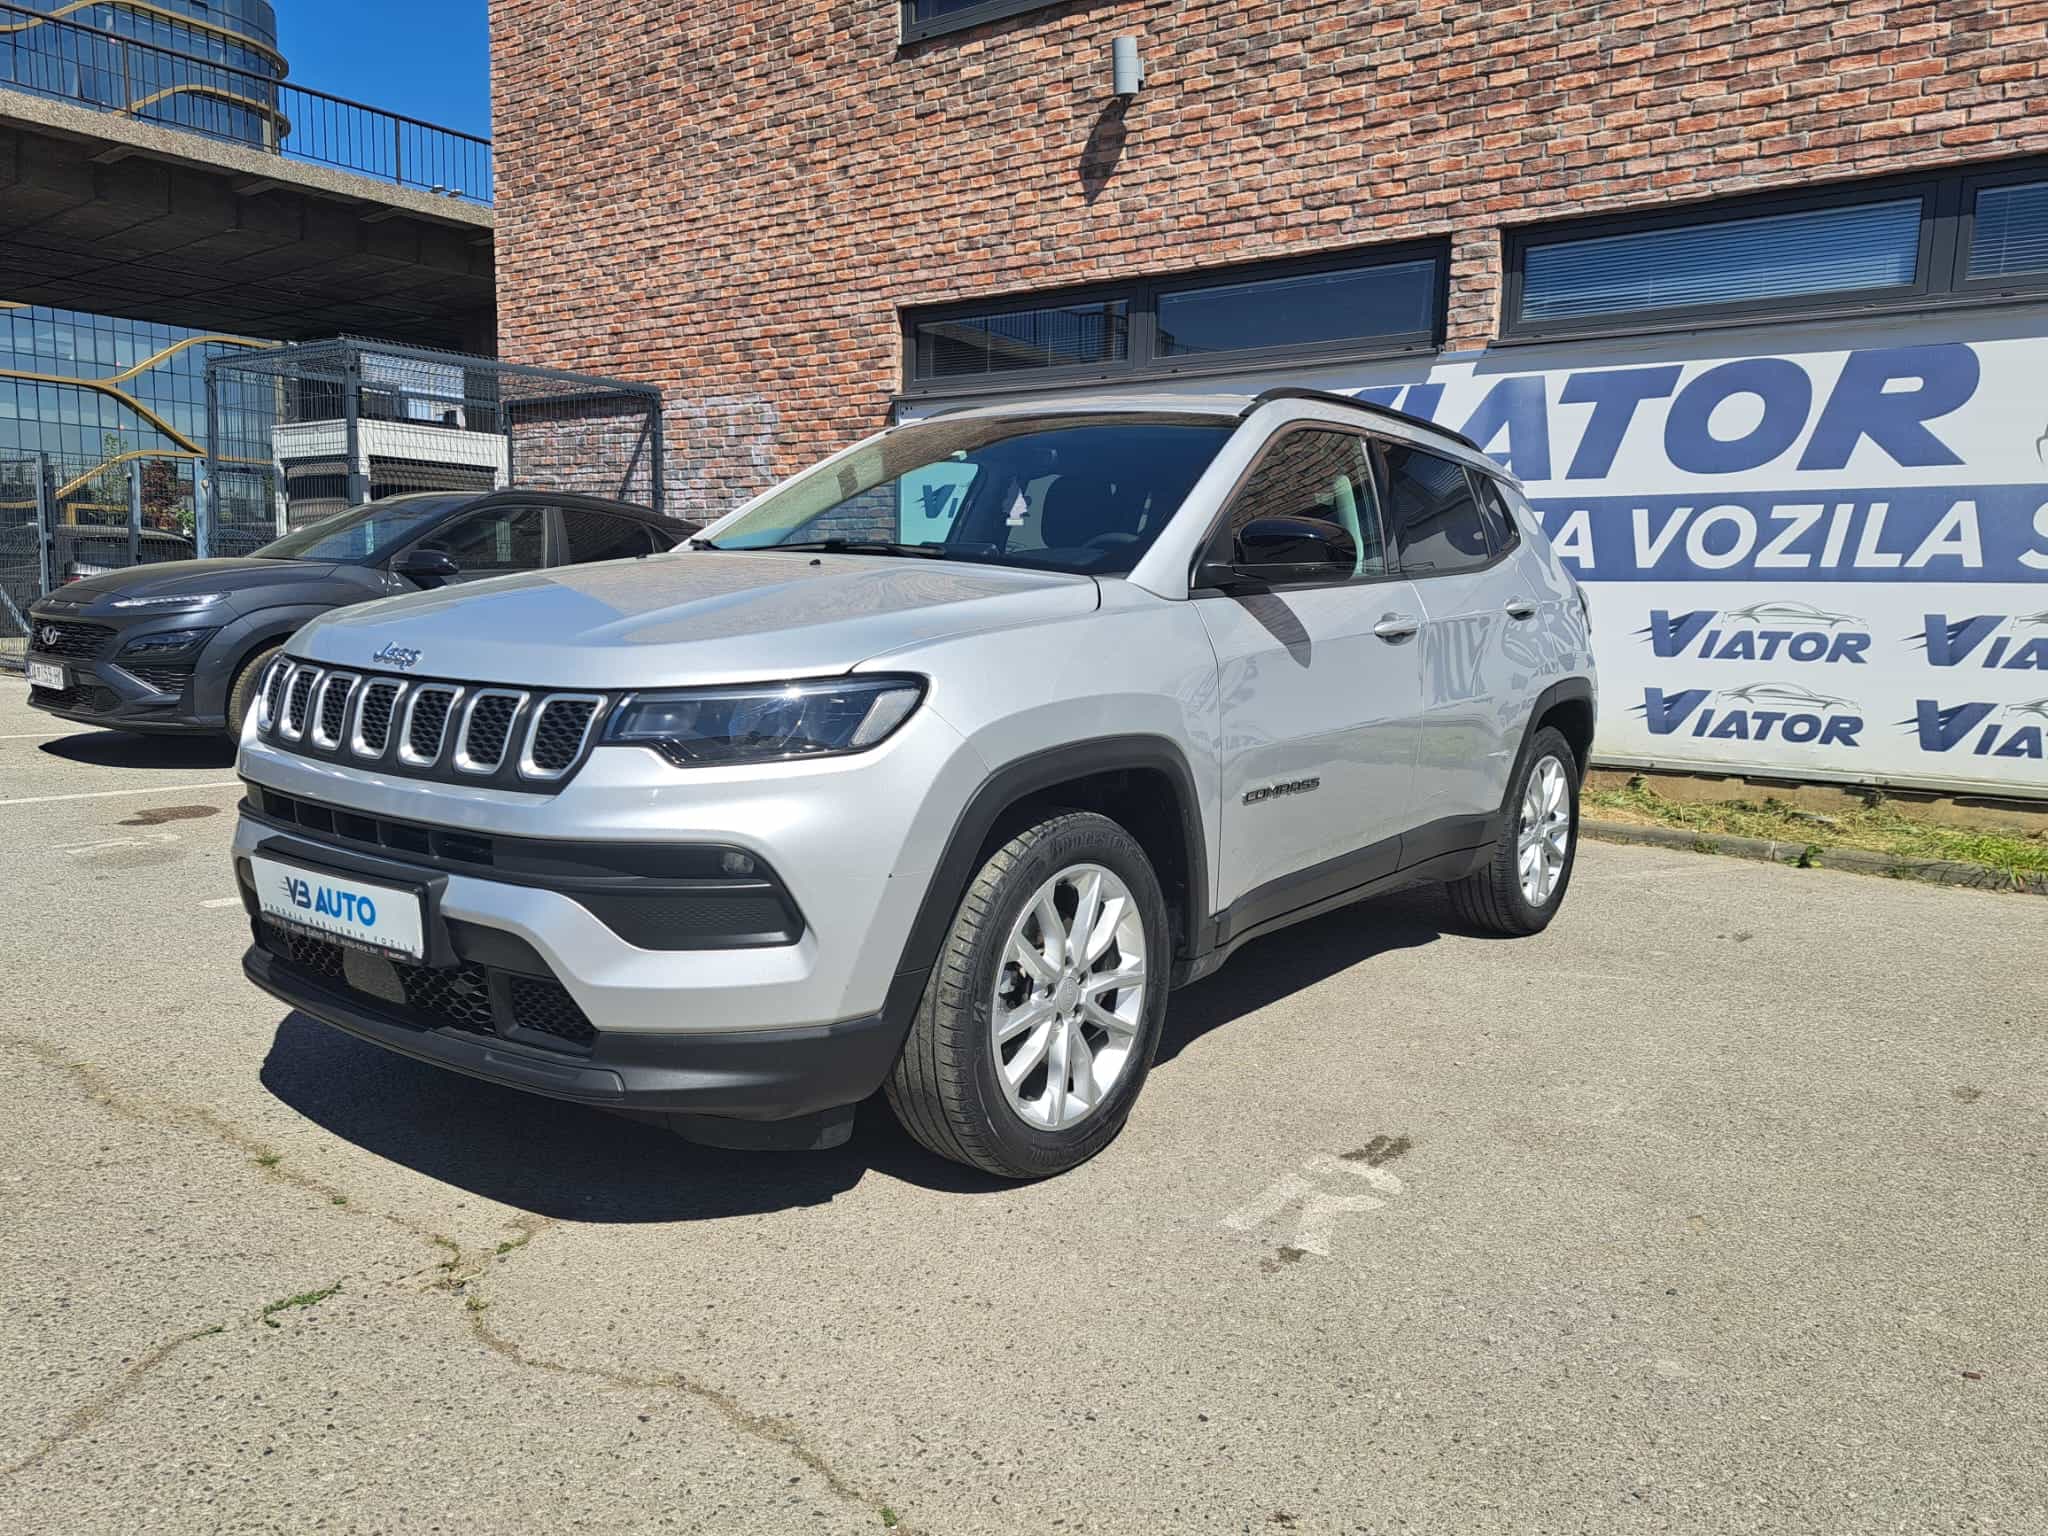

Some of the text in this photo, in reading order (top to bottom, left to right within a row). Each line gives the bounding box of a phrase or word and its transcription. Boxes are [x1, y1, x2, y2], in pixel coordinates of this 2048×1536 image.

[1352, 343, 1981, 480] ATOR
[1631, 499, 1984, 570] VOZILA
[373, 640, 423, 671] Jeep
[1645, 609, 1872, 664] VIATOR
[1640, 687, 1865, 748] VIATOR
[1242, 777, 1321, 806] COMPASS
[314, 885, 377, 927] AUTO
